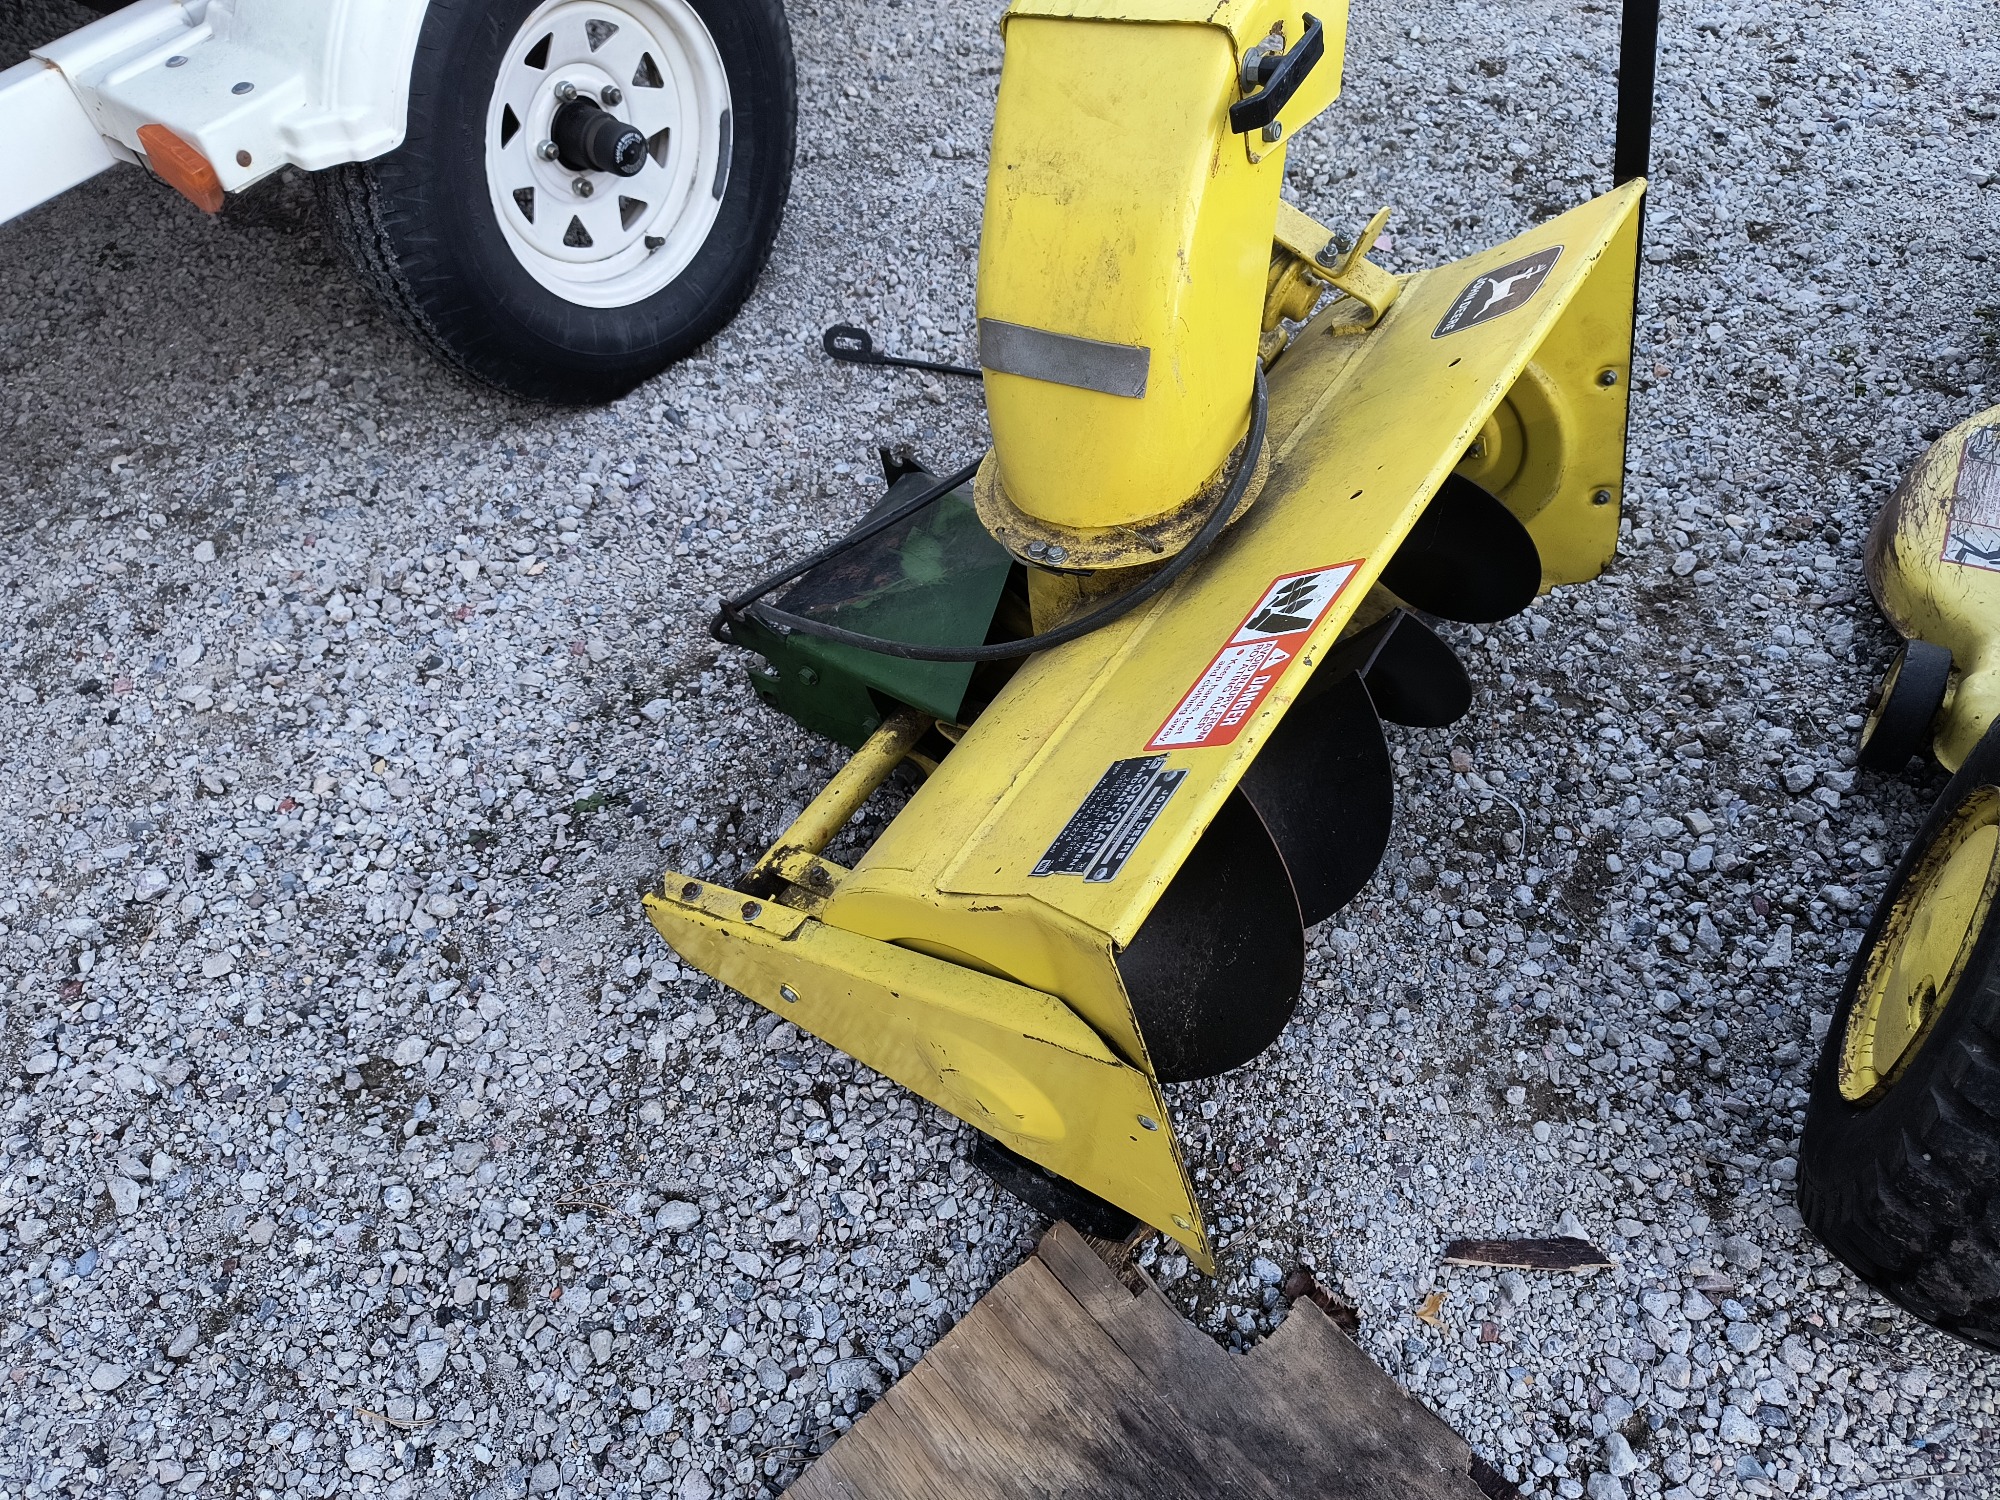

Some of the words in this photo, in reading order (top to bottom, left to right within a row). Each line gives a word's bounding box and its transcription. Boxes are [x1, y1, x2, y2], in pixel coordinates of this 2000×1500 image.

[1464, 277, 1488, 301] JOHN
[1442, 300, 1472, 332] DEERE
[1209, 661, 1225, 676] and
[1216, 659, 1238, 681] Keep
[1222, 644, 1264, 692] ROTATING
[1248, 643, 1272, 671] AVOID
[1179, 680, 1210, 714] clothing
[1189, 684, 1218, 714] hands,
[1220, 674, 1250, 707] INJURY
[1220, 675, 1271, 726] DANGER
[1174, 717, 1193, 734] feet
[1194, 696, 1224, 729] AUGER
[1195, 712, 1222, 740] FROM
[1112, 760, 1152, 807] HARDWARE
[1086, 776, 1148, 853] CORCORAN
[1145, 790, 1168, 817] JOHN
[1066, 821, 1106, 870] IMPLEMENT
[1116, 823, 1146, 859] DEERE
